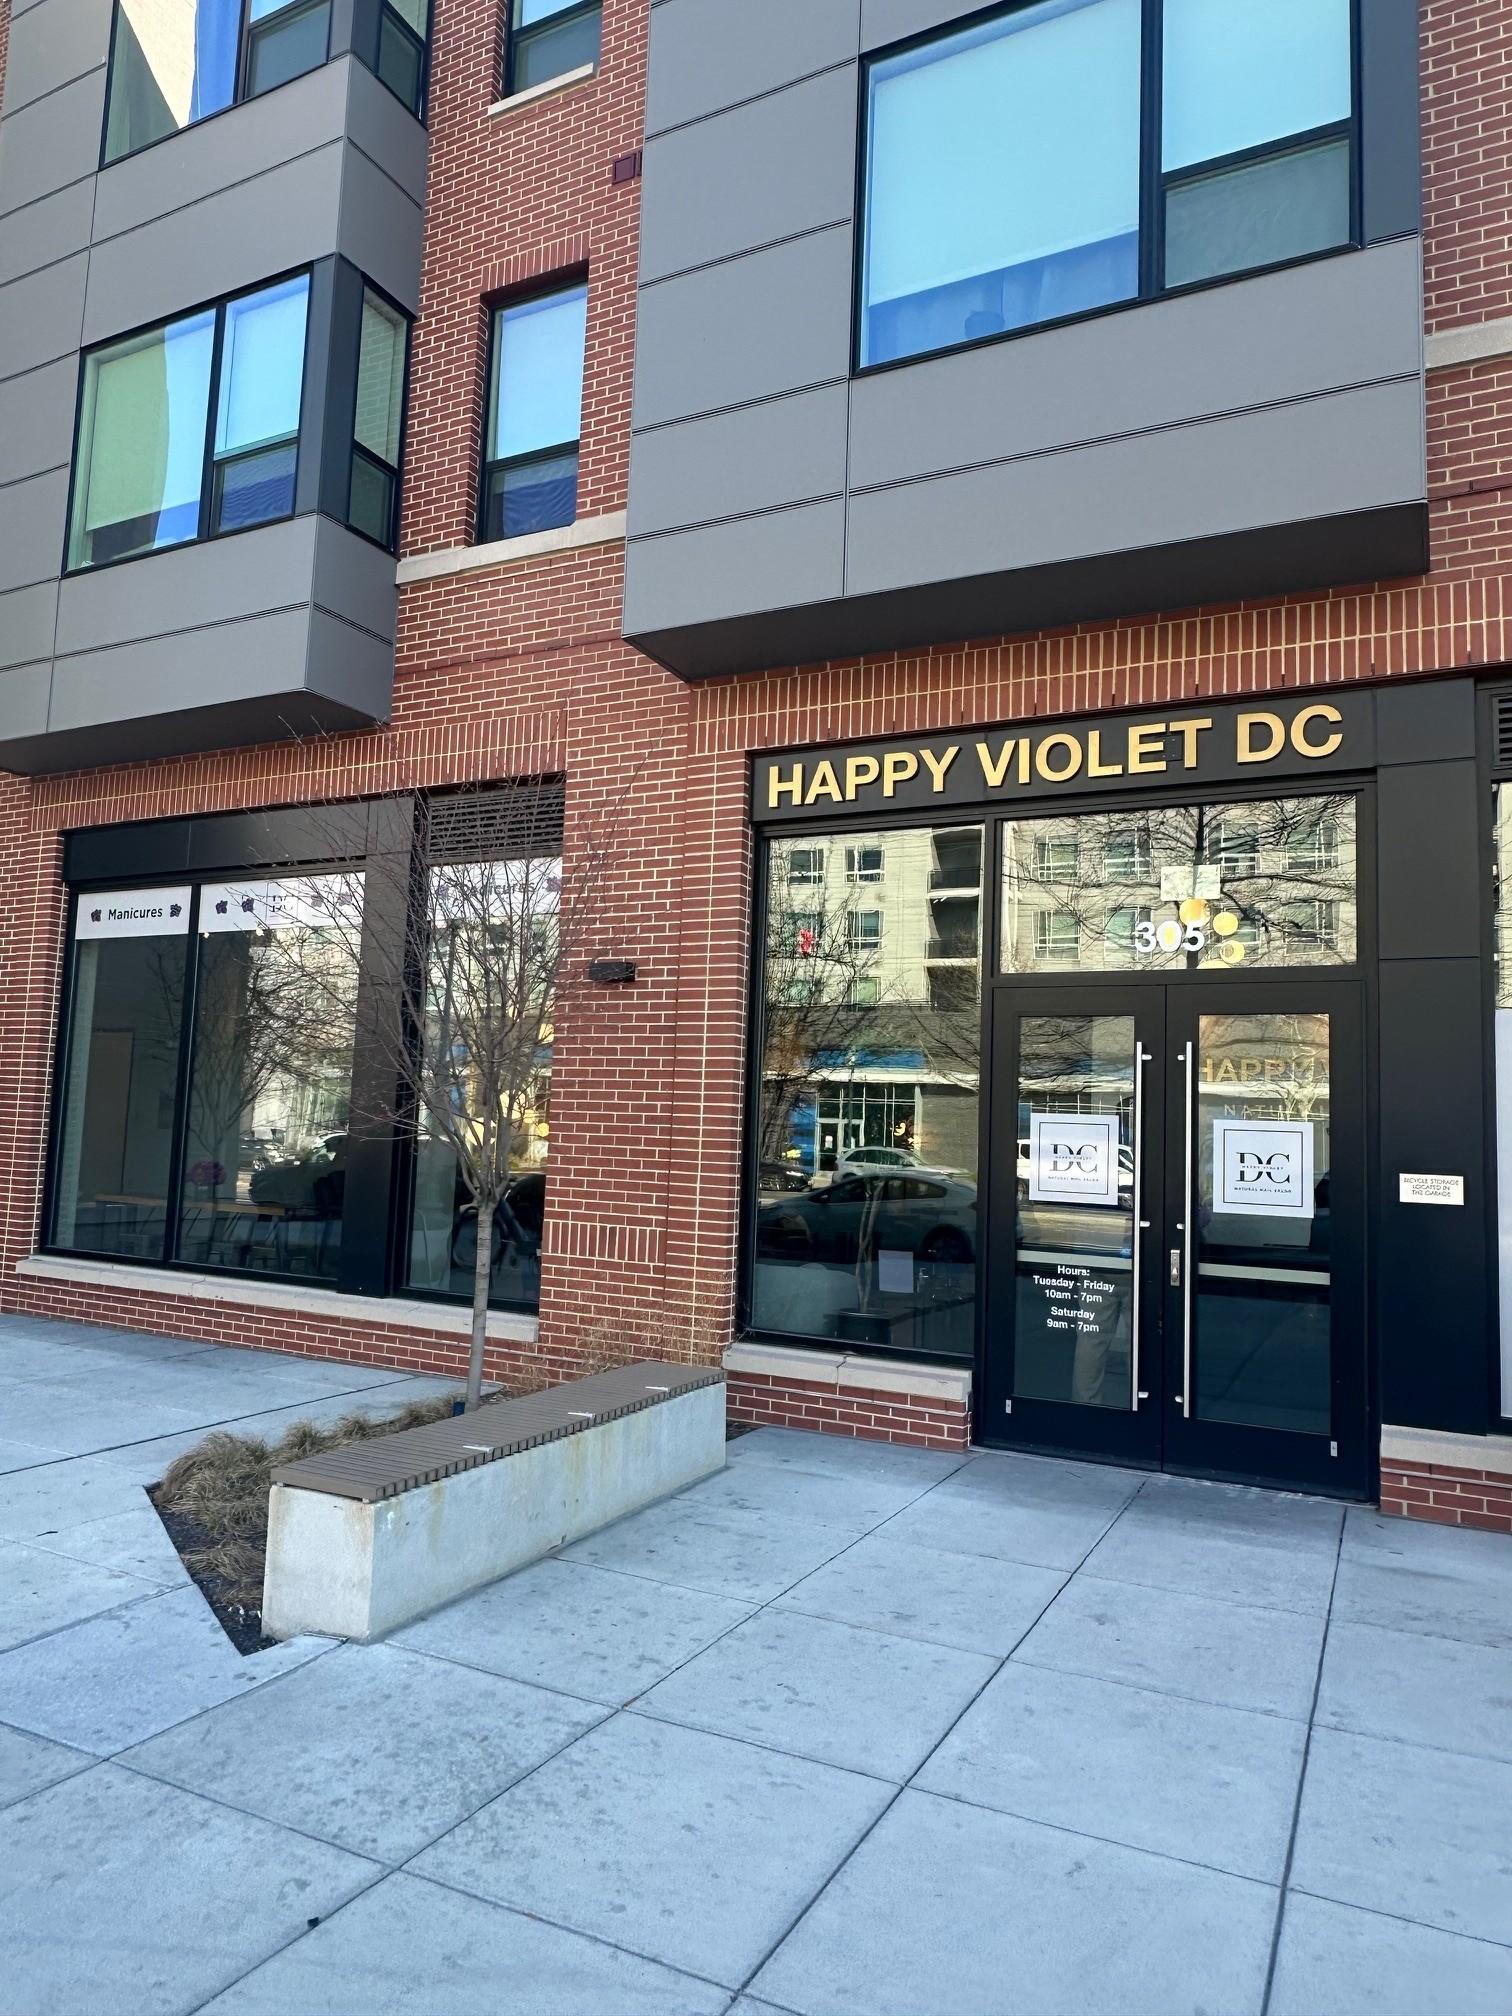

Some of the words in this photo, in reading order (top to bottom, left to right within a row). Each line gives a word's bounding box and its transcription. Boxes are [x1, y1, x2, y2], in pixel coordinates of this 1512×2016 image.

[768, 746, 960, 808] HAPPY
[975, 718, 1212, 787] VIOLET
[1237, 704, 1344, 763] DC
[108, 907, 163, 920] Manicures
[1134, 920, 1204, 953] 305
[1049, 1143, 1098, 1174] DC
[1236, 1151, 1290, 1184] DC
[1430, 1178, 1459, 1186] STORAGE
[1057, 1265, 1090, 1276] Hours:
[1033, 1275, 1074, 1289] Tuesday
[1083, 1280, 1115, 1292] Friday
[1044, 1289, 1071, 1300] 10am
[1080, 1292, 1103, 1303] 7pm
[1050, 1306, 1095, 1320] Saturday
[1046, 1318, 1068, 1329] 9am
[1077, 1321, 1099, 1332] 7pm
